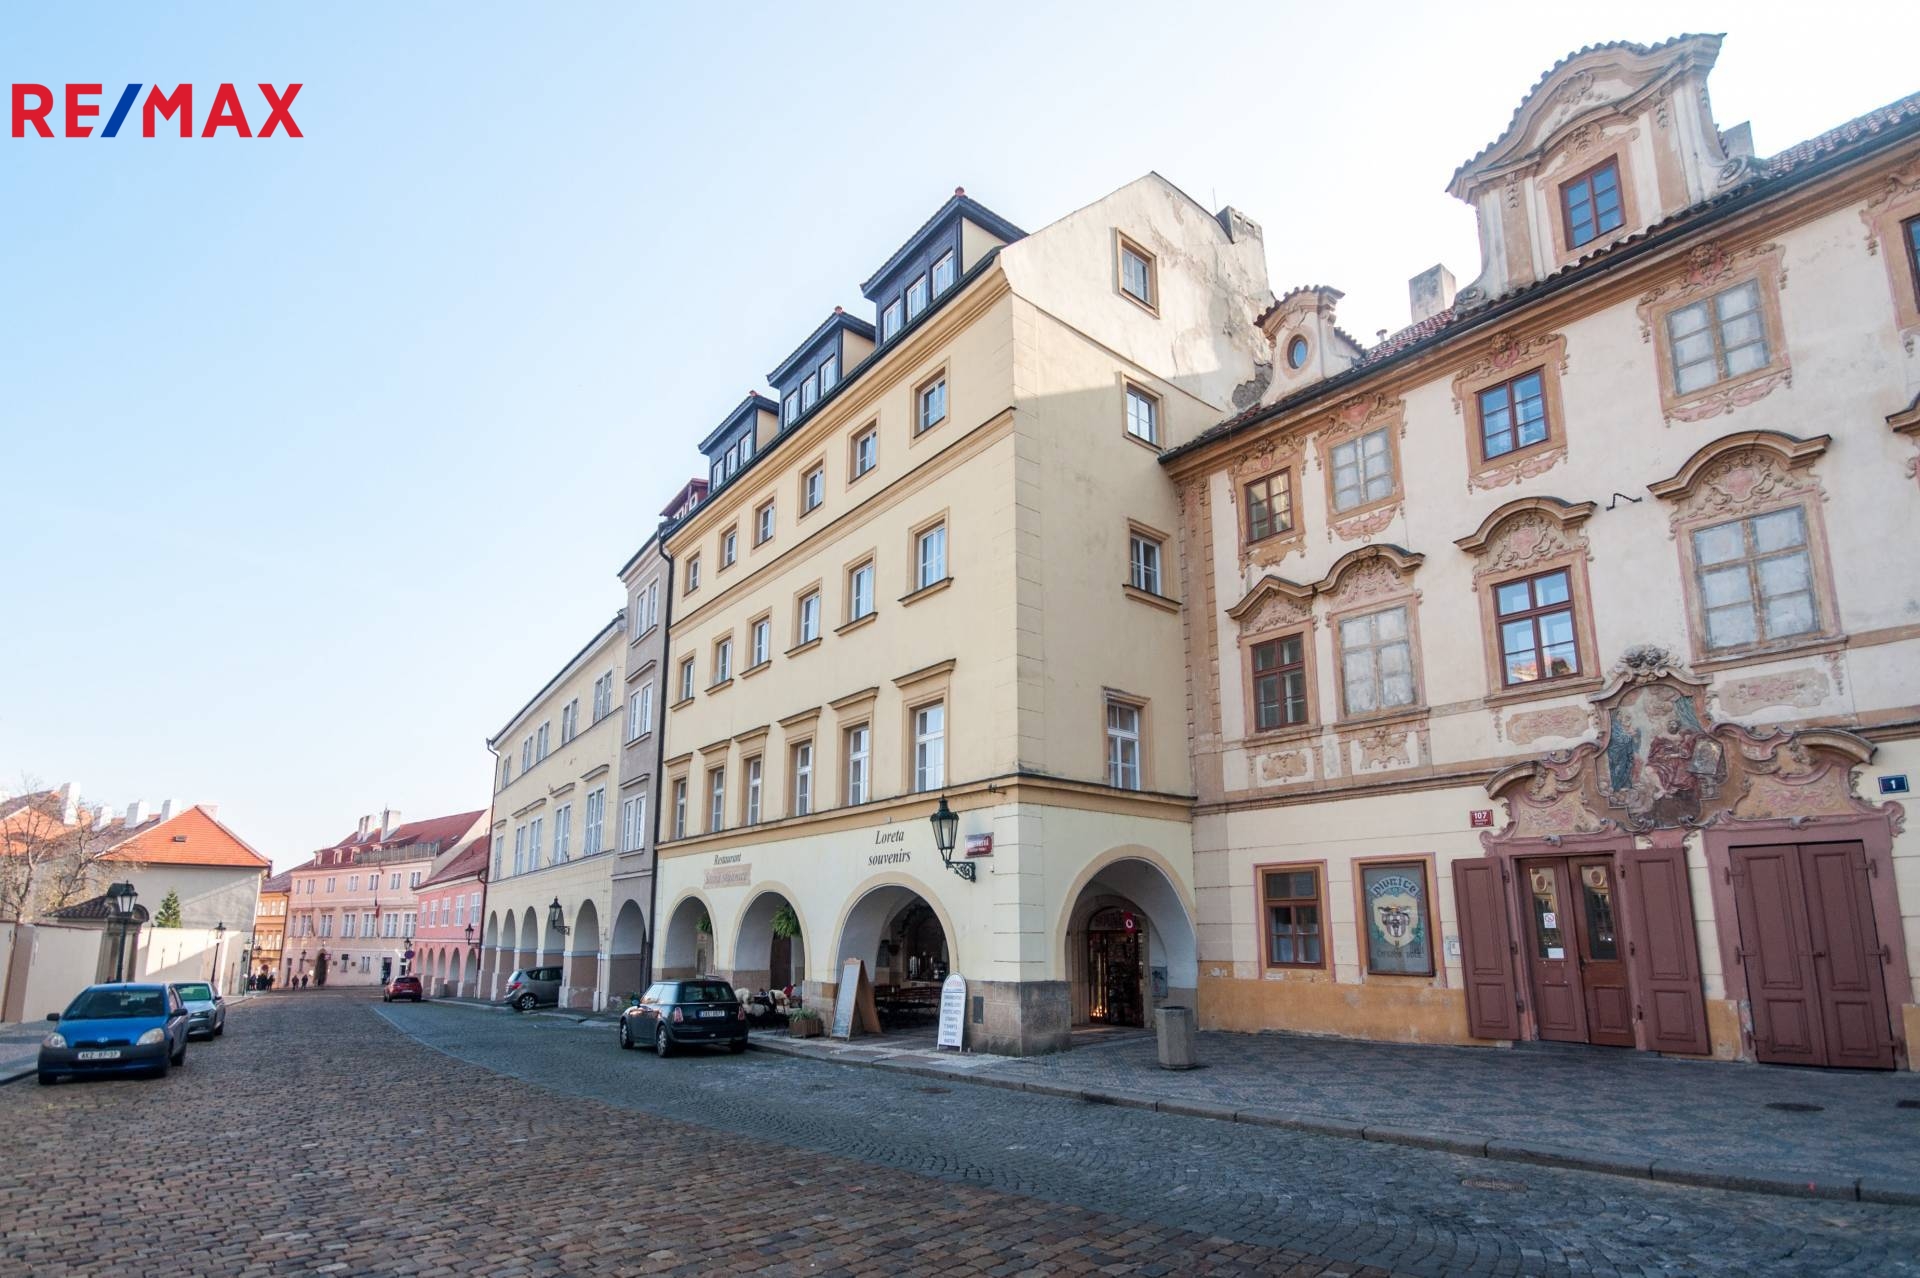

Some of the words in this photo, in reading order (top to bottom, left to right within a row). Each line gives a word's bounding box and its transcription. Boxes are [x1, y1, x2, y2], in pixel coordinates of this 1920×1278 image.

[1890, 779, 1896, 790] 1
[875, 830, 905, 845] Loreta
[713, 851, 741, 865] Restaurant
[868, 847, 912, 866] souvenirs
